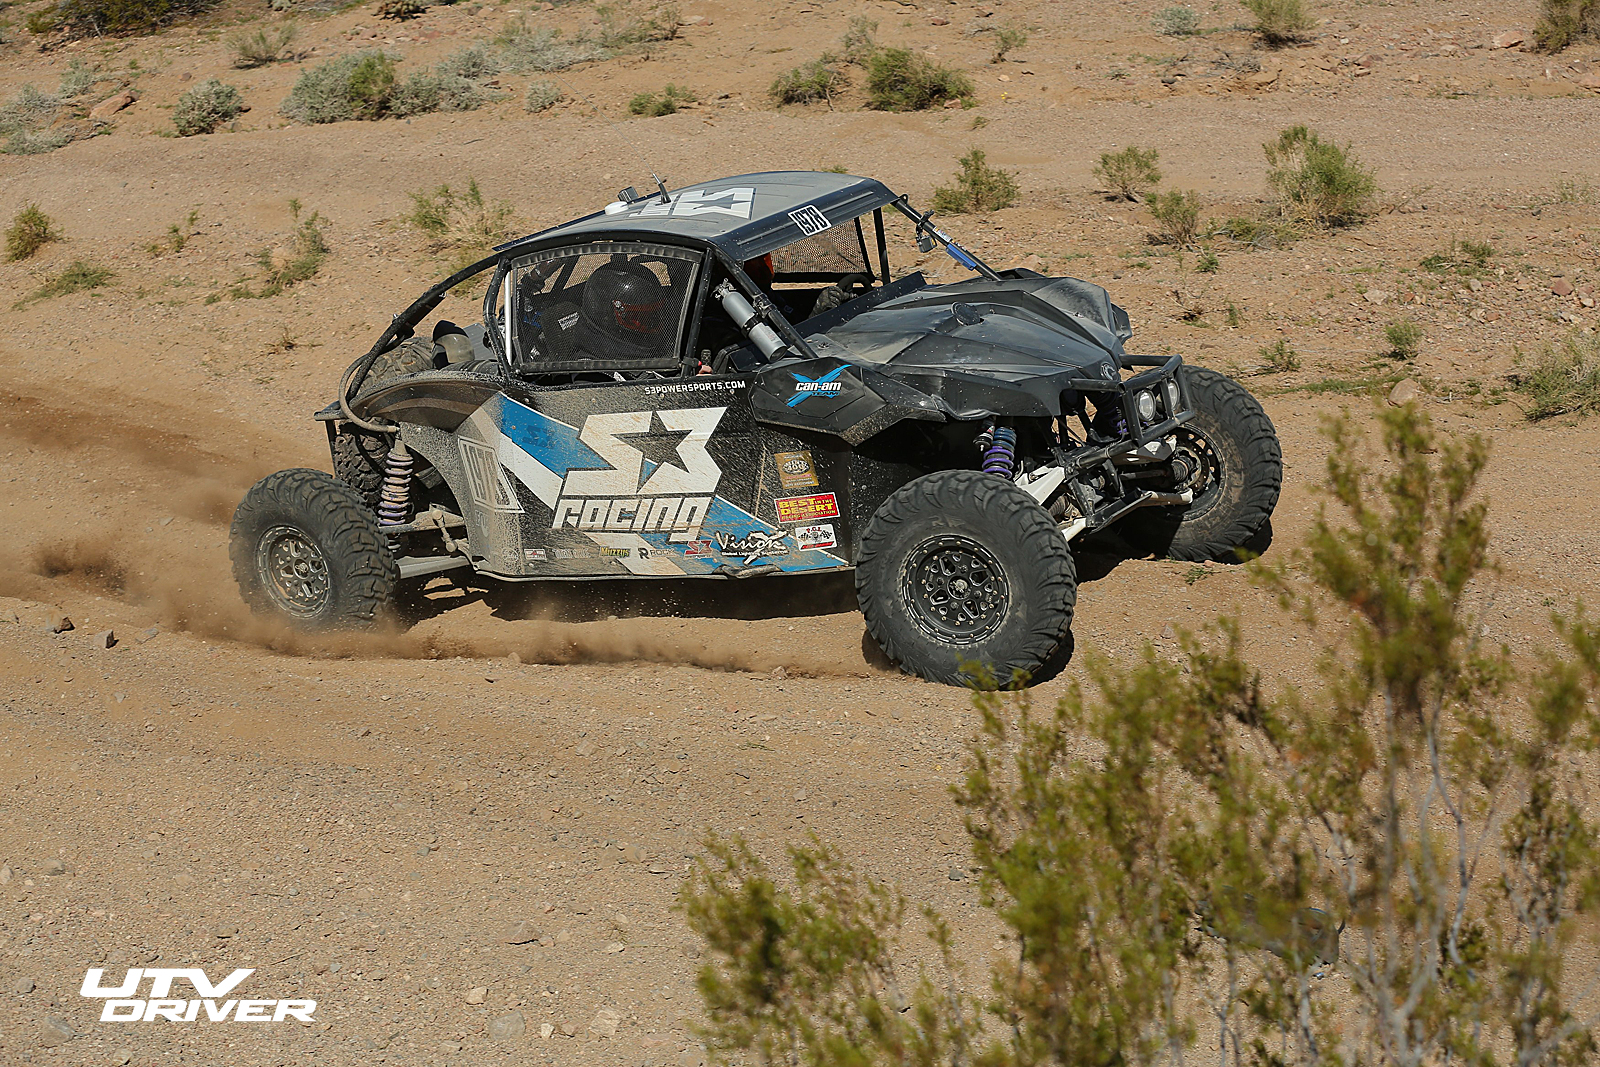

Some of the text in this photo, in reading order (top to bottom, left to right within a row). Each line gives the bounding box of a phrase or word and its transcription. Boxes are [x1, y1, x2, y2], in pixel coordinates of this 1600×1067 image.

[791, 207, 828, 235] 1978
[644, 380, 746, 395] S3POWERSPORTS.COM
[795, 382, 842, 391] can-am
[562, 406, 728, 496] S3
[778, 498, 816, 508] BEST
[780, 503, 834, 515] DESERT
